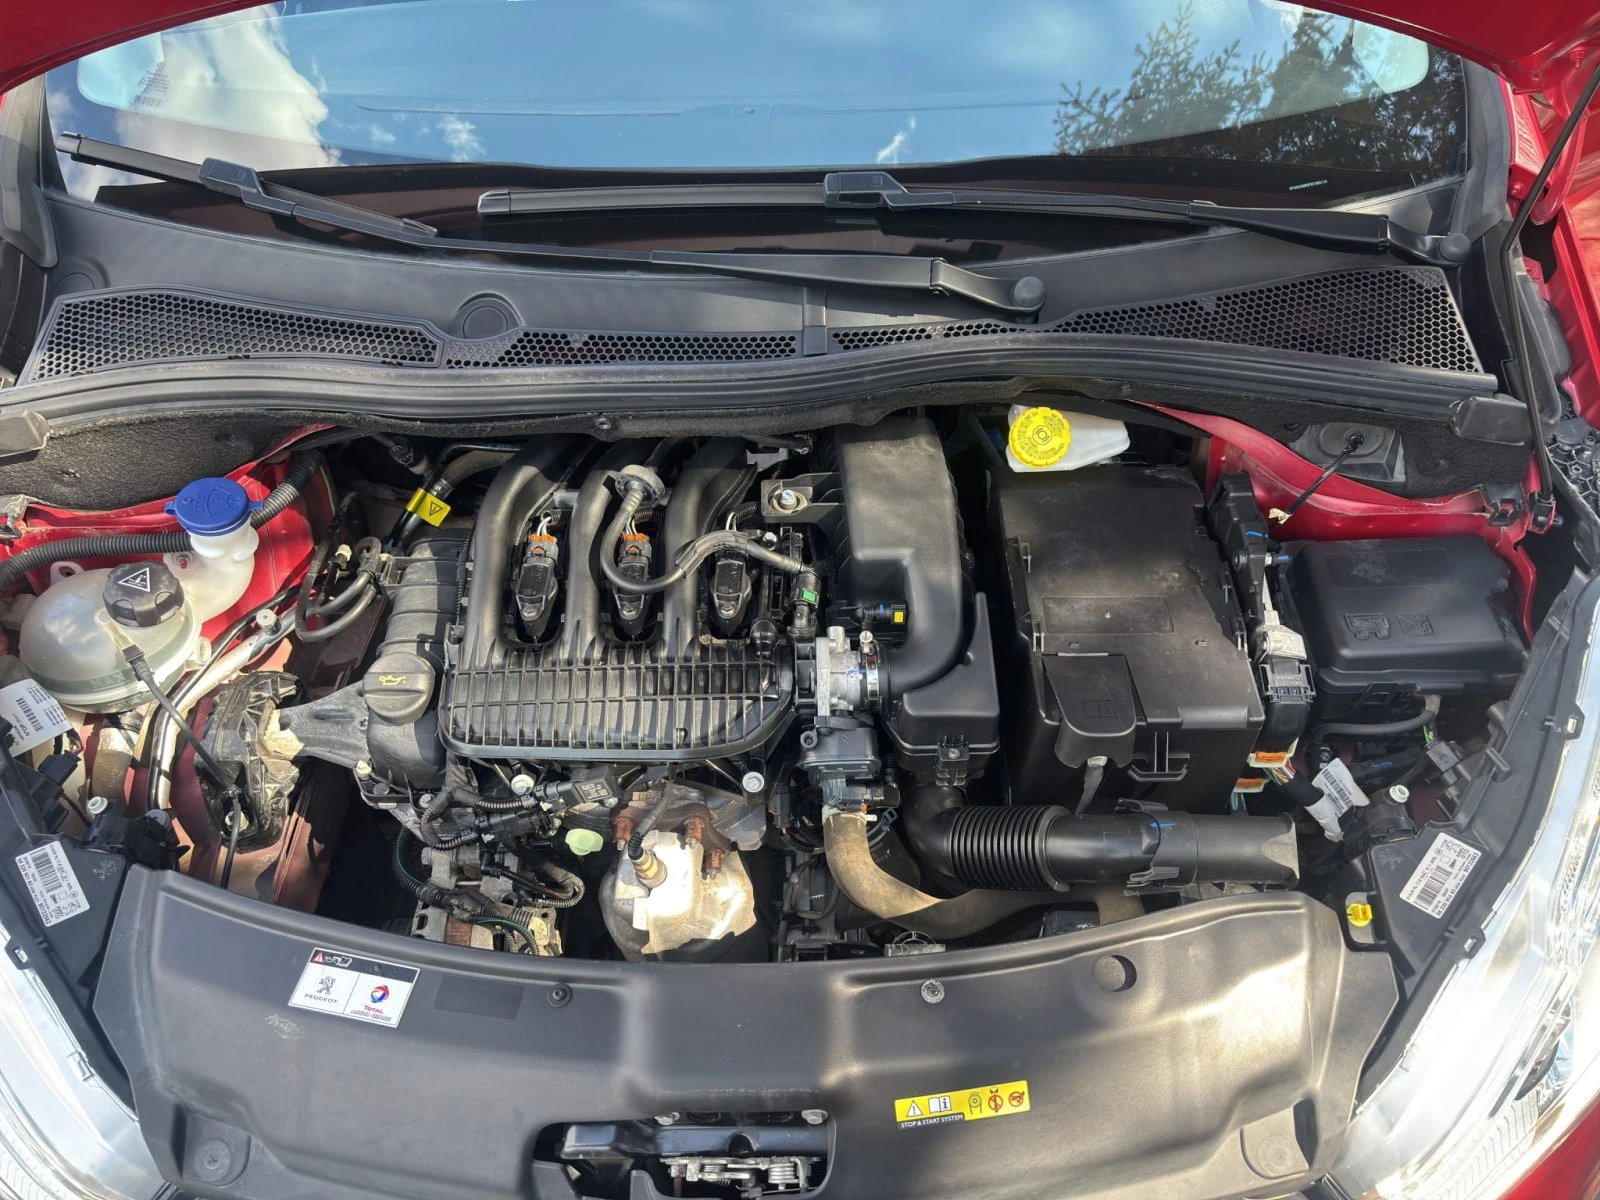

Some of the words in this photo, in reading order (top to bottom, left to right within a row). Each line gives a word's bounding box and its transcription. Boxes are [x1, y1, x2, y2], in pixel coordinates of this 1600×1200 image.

[304, 993, 337, 1004] PEUGEOT
[363, 1004, 383, 1014] TOTAL
[922, 1117, 940, 1125] START
[941, 1114, 963, 1122] SYSTEM
